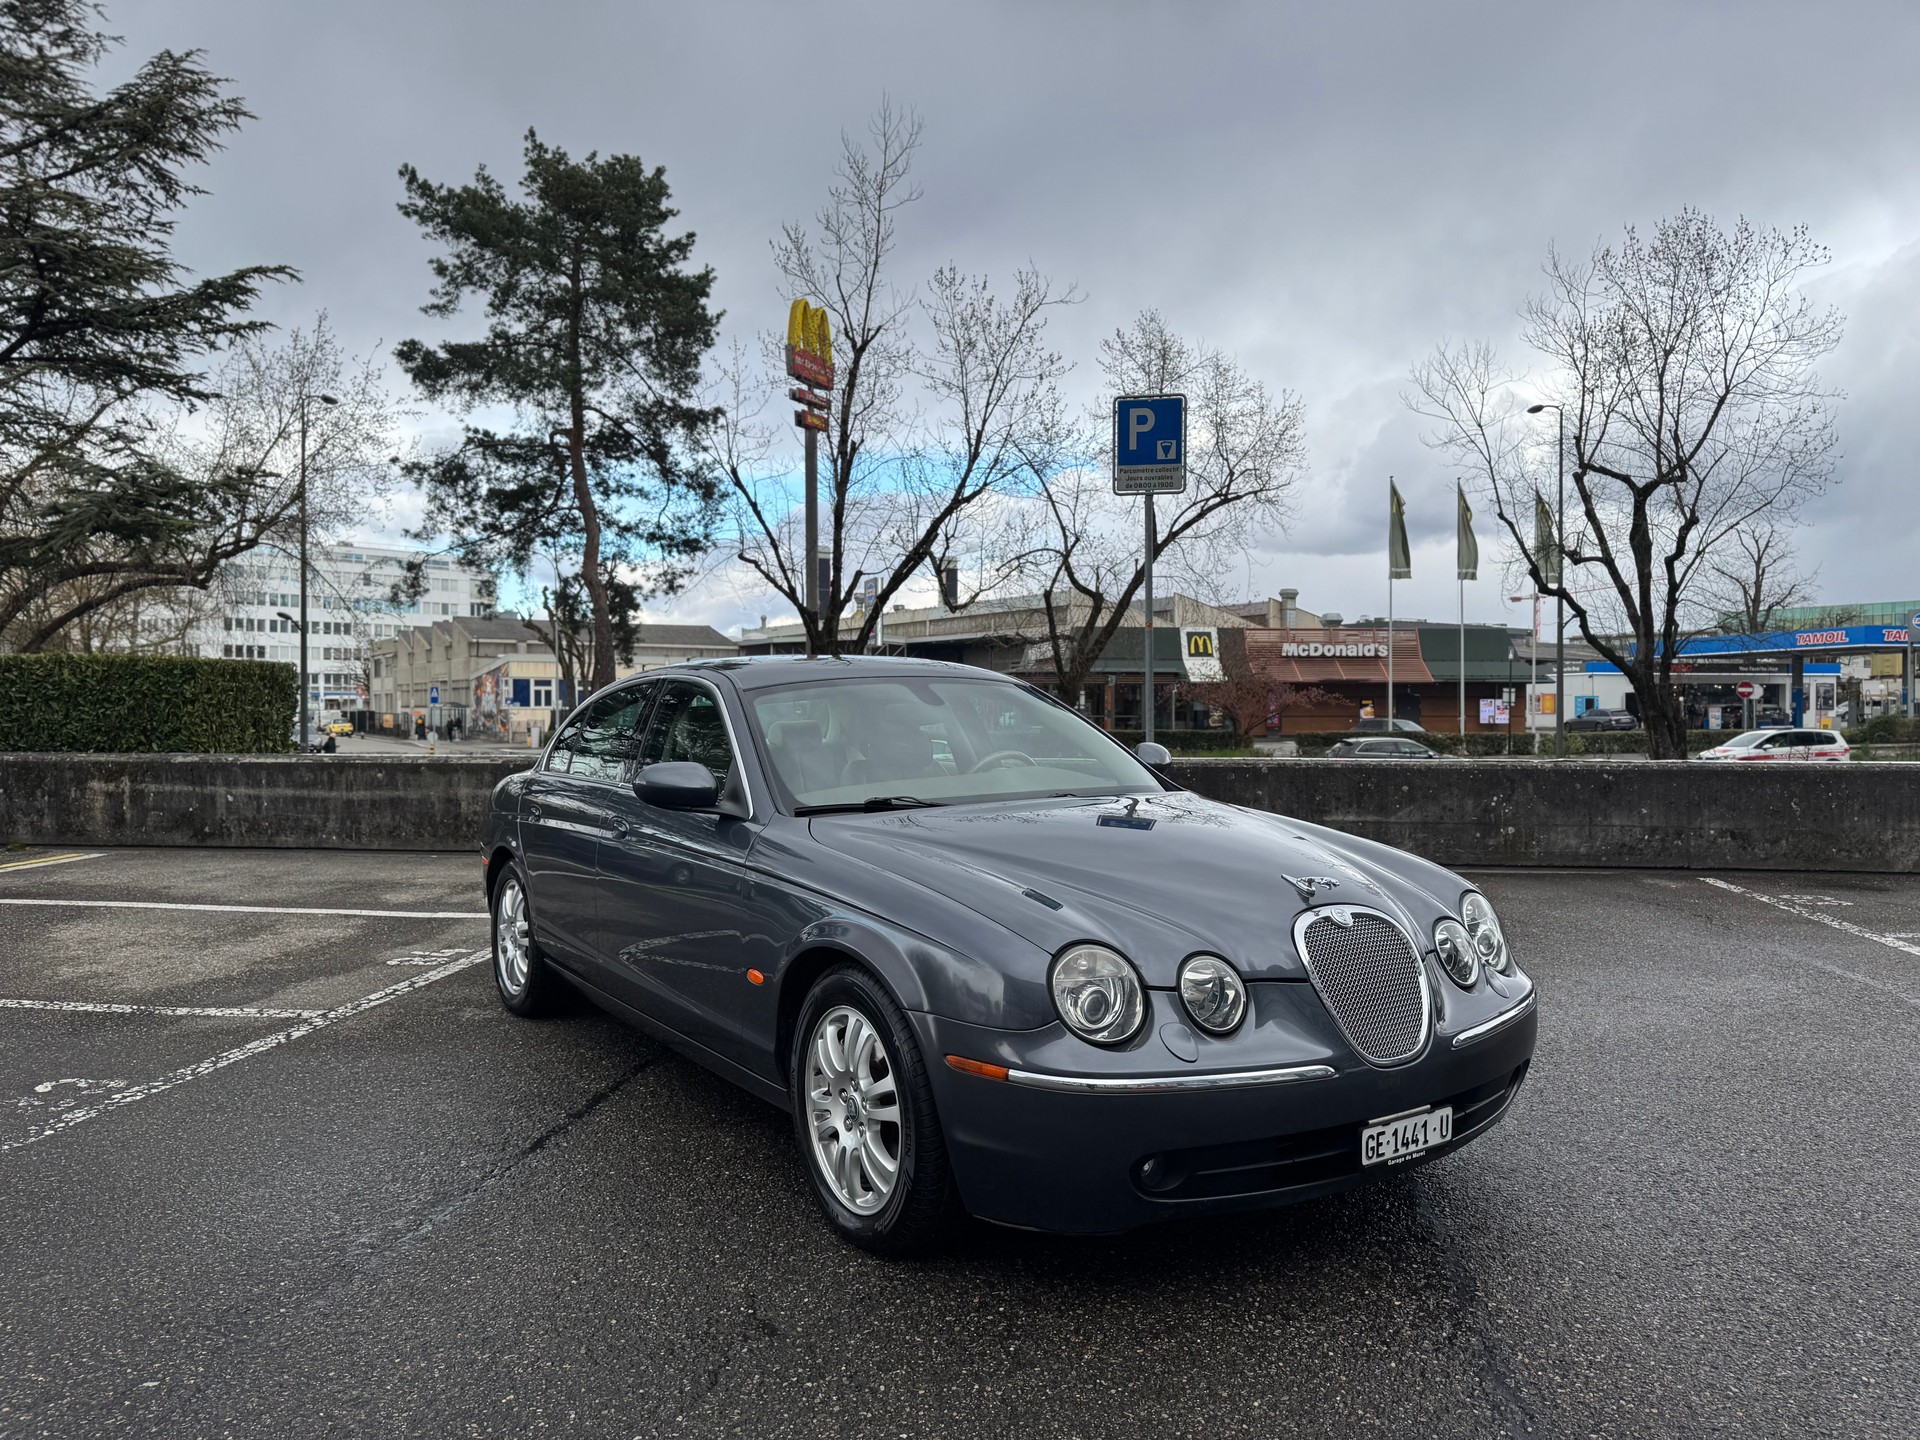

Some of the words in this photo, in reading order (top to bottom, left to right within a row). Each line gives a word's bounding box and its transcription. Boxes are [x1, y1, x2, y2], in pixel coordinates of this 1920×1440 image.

[1128, 407, 1156, 451] P
[1119, 467, 1154, 475] Parcomètre
[1796, 630, 1850, 645] TAMOIL
[1281, 642, 1389, 657] McDonald's
[1387, 1157, 1405, 1166] Garage
